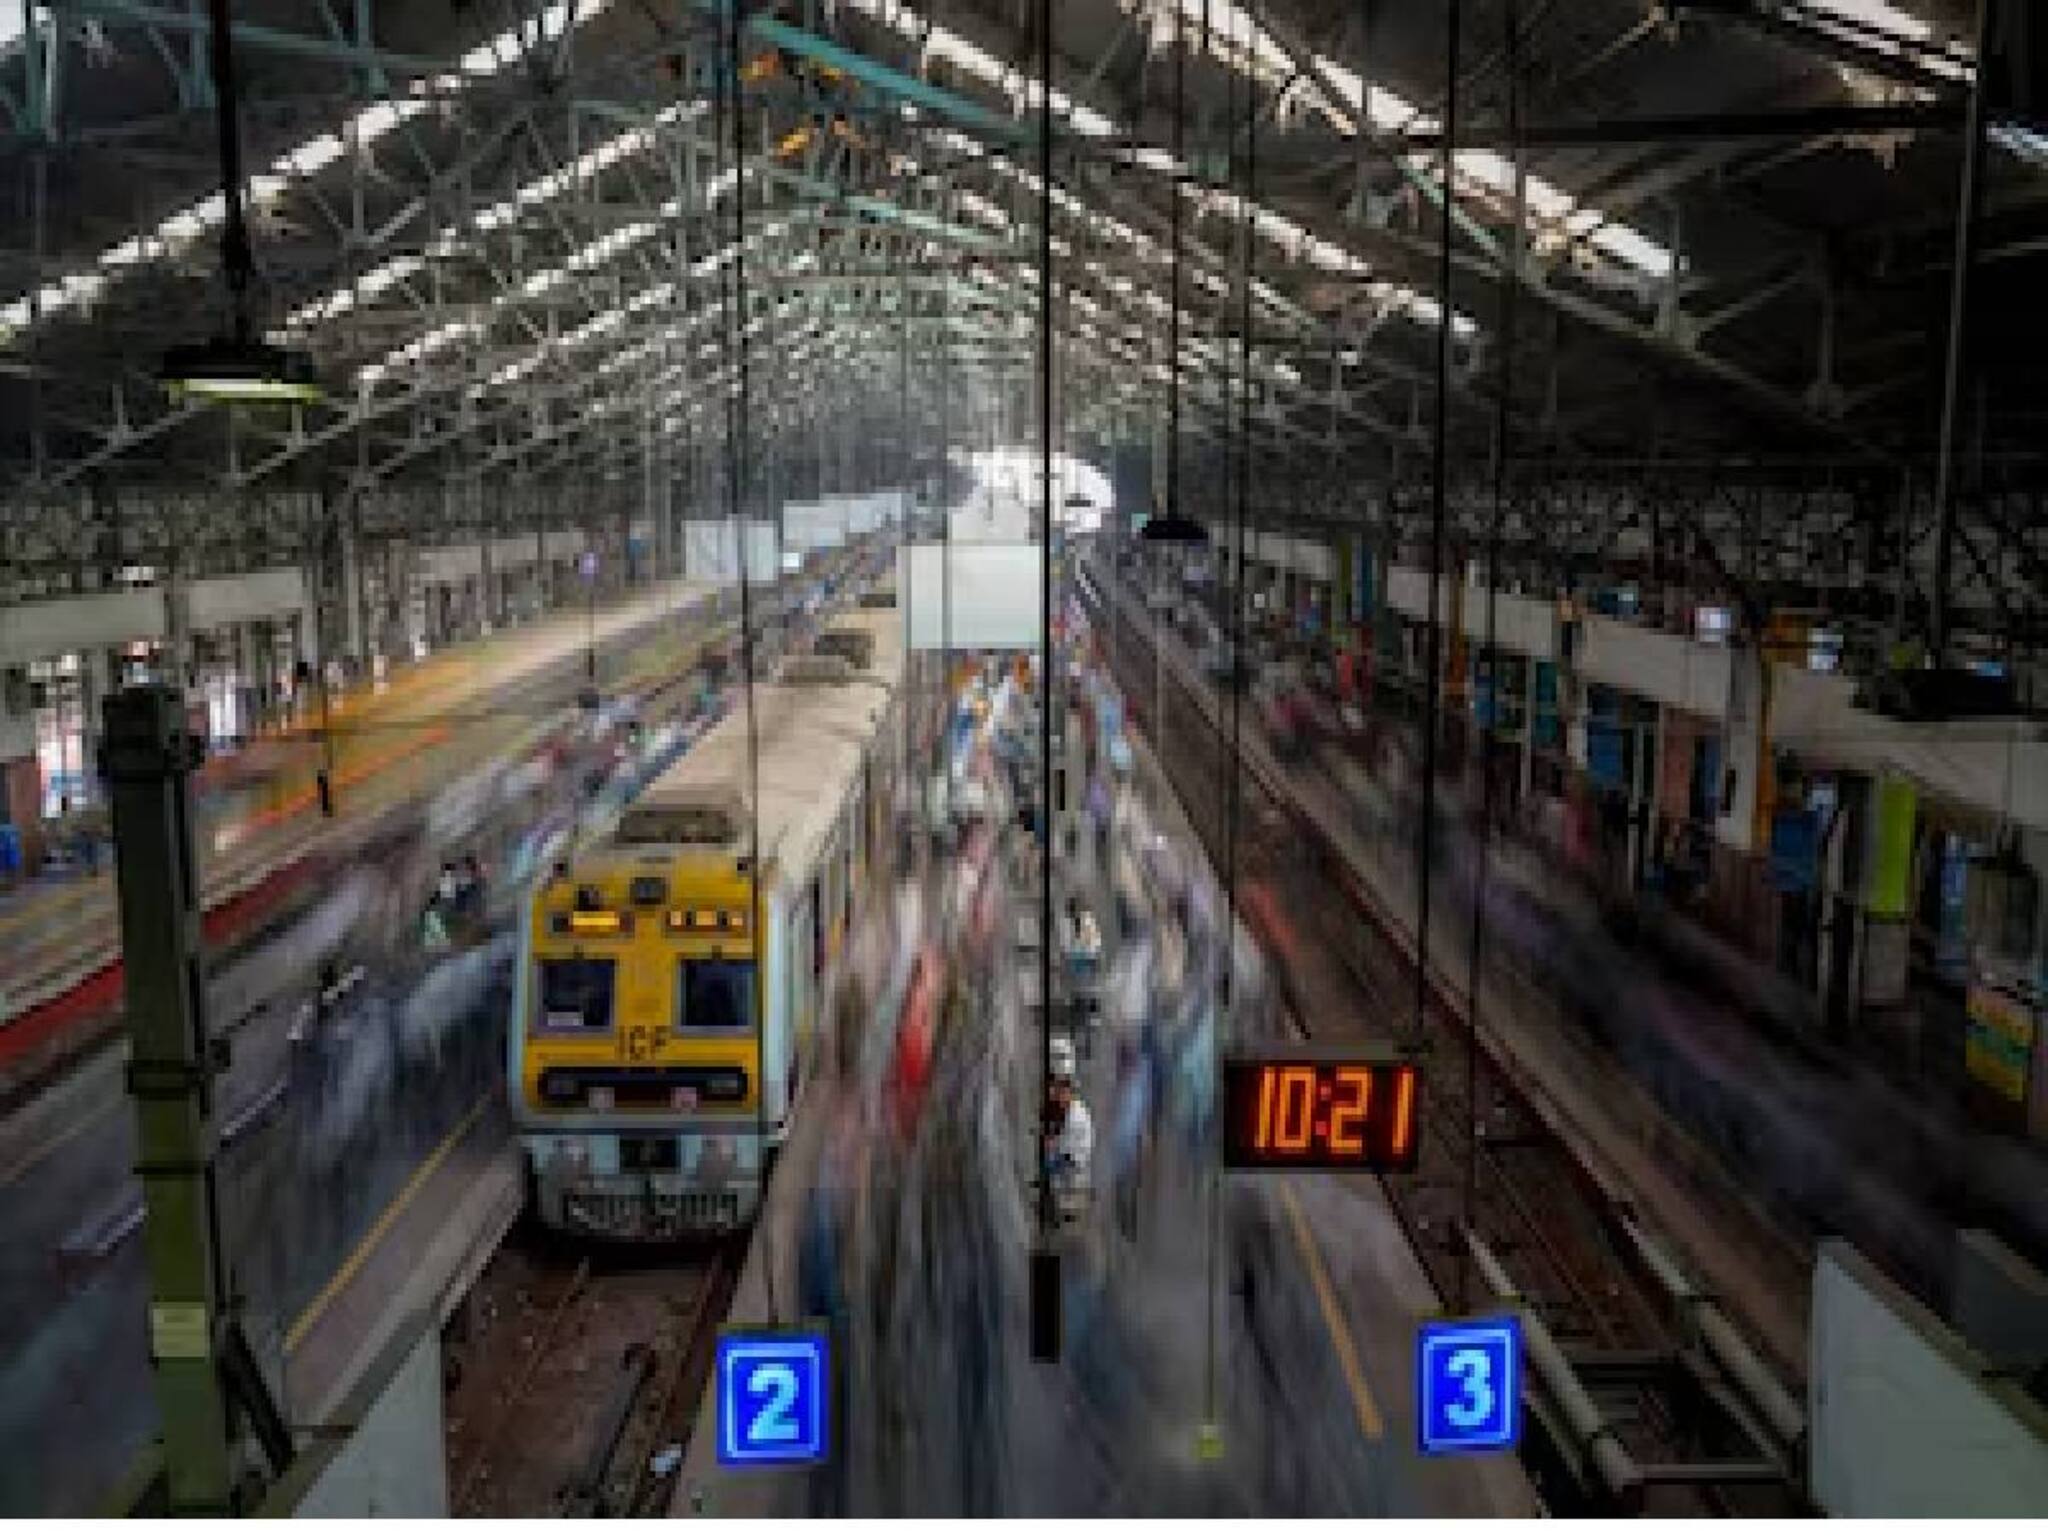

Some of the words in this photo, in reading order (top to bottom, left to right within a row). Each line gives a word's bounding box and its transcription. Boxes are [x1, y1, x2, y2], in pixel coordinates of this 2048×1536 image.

[1254, 1066, 1414, 1154] 10:21
[747, 1363, 800, 1440] 2
[1443, 1349, 1496, 1426] 3
